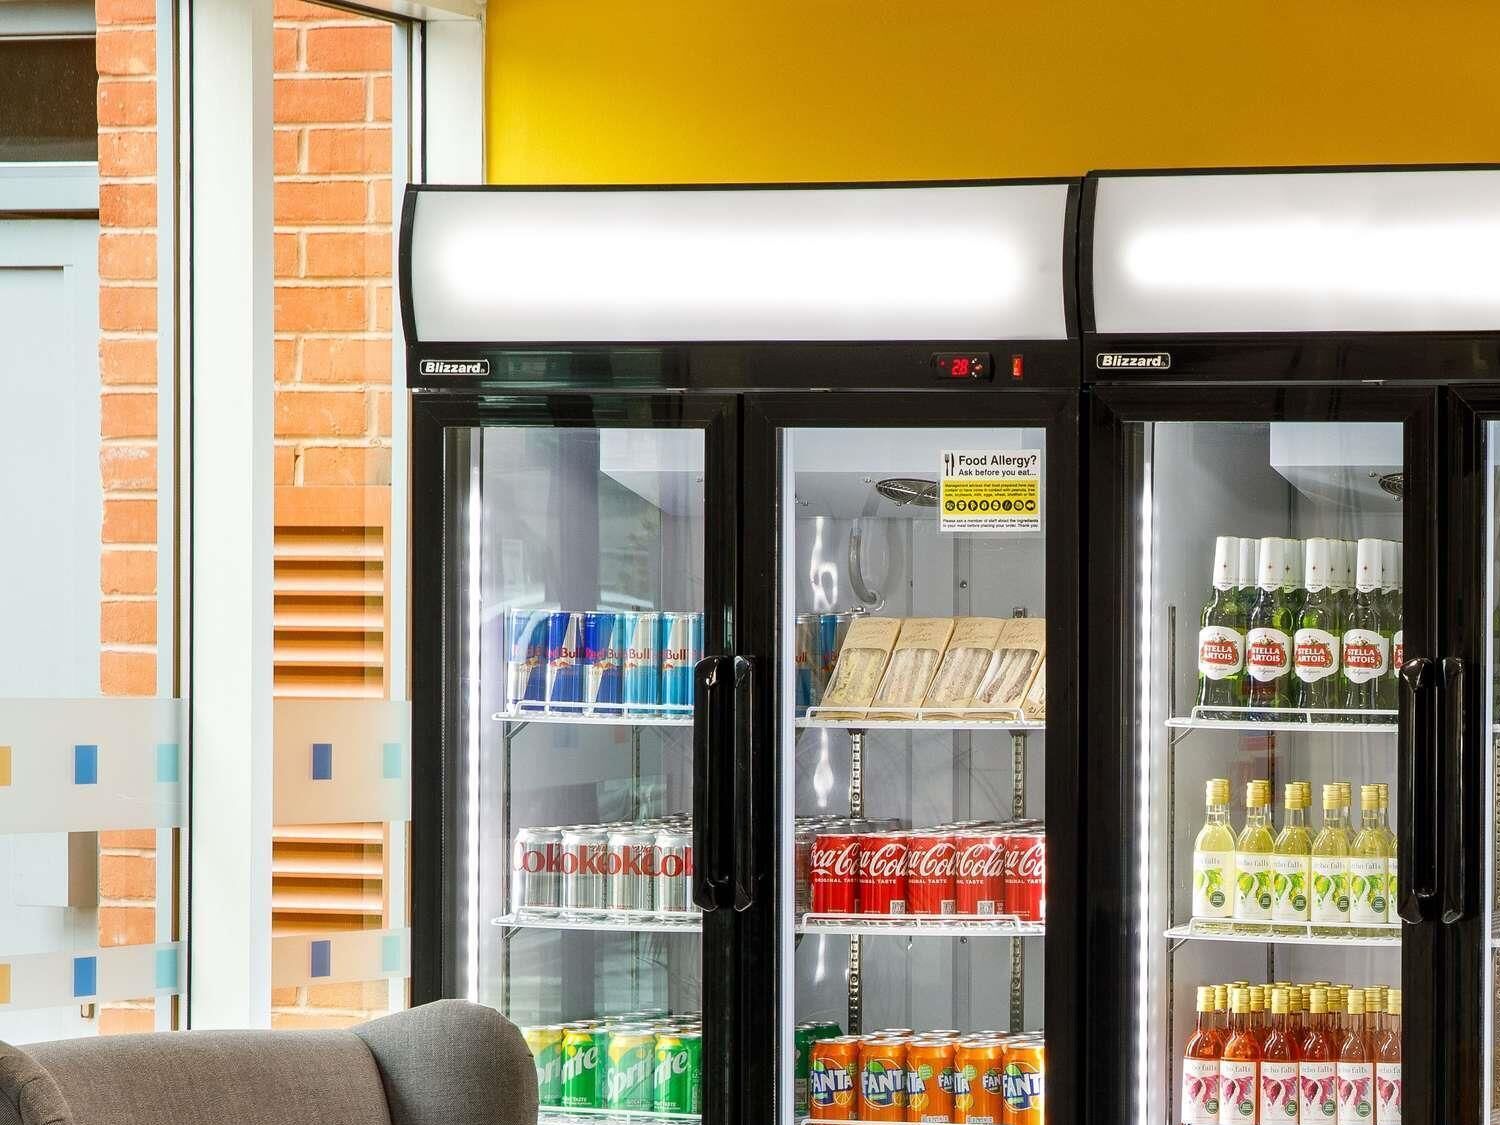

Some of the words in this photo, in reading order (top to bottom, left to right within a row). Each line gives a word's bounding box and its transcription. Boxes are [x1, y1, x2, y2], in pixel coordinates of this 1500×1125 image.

[1102, 355, 1161, 367] Blizzard
[425, 362, 481, 373] Blizzard
[959, 455, 987, 466] Food
[991, 454, 1037, 468] Allergy?
[1203, 645, 1232, 653] STELLA
[1251, 647, 1280, 655] STELLA
[1347, 648, 1375, 656] STELLA
[1203, 652, 1232, 660] ARTOIS
[1251, 654, 1280, 662] ARTOIS
[1347, 655, 1375, 663] ARTOIS
